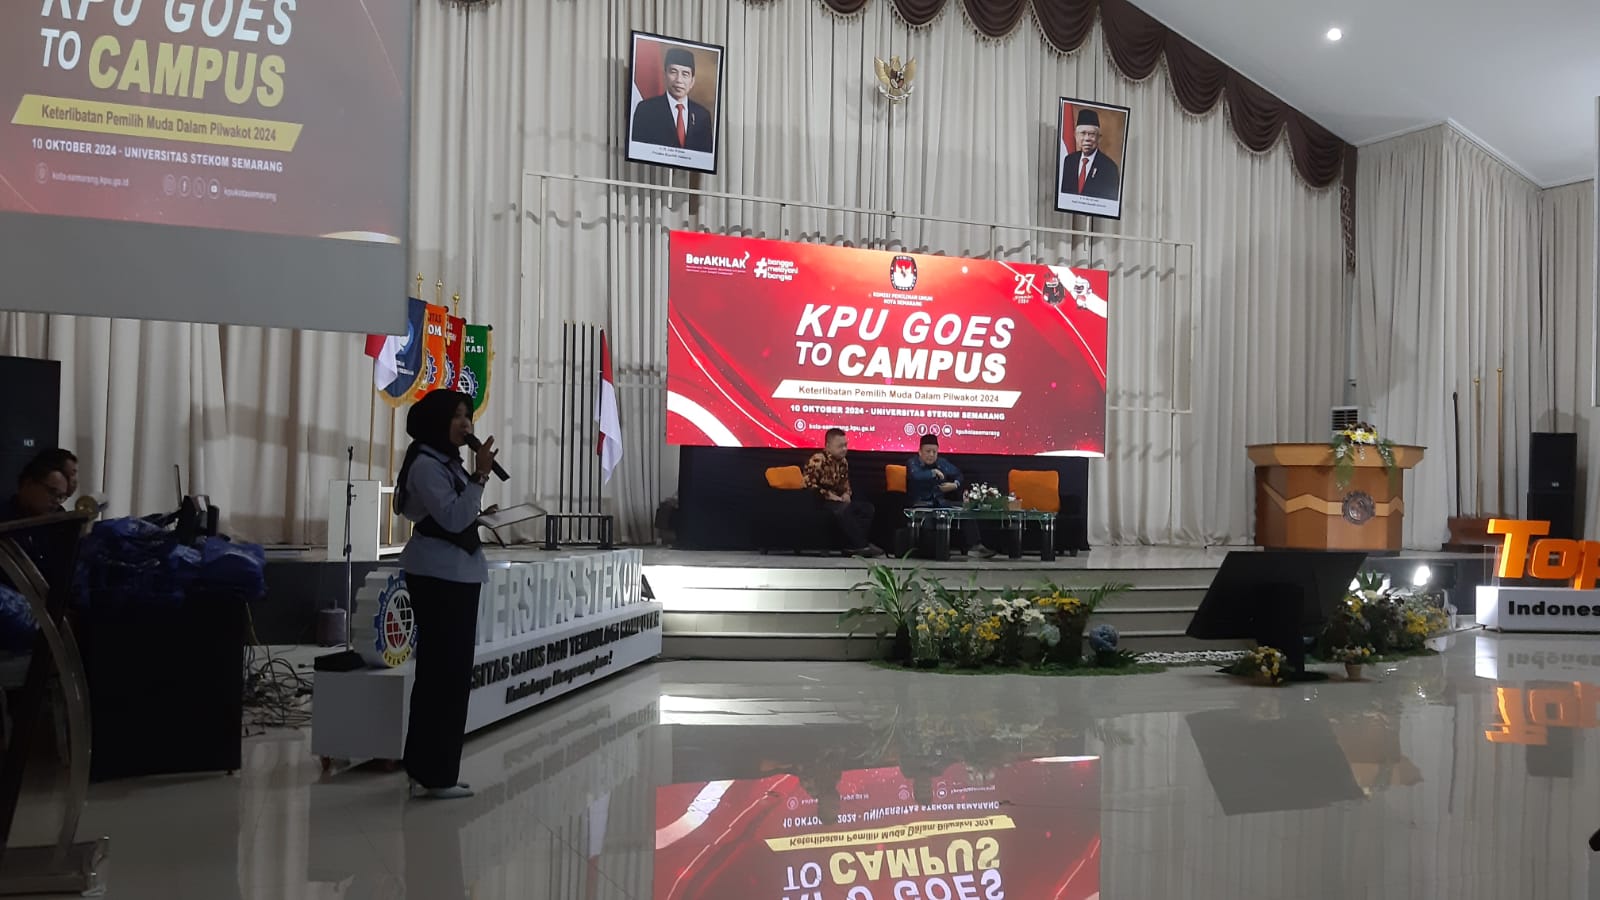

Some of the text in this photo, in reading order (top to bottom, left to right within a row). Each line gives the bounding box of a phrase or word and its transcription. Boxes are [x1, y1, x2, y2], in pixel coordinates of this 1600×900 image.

[164, 0, 296, 46] GOES
[40, 28, 285, 107] TO CAMPUS
[41, 104, 276, 141] Keterlibatan Pemilih Muda Dalam Pilwakot 2024
[32, 138, 43, 149] 10
[45, 139, 92, 154] OKTOBER
[94, 144, 117, 156] 2024
[124, 146, 188, 163] UNIVERSITAS
[190, 154, 229, 167] STEKOM
[231, 157, 283, 173] SEMARANG
[686, 253, 746, 269] BerAKHLAK
[1014, 273, 1036, 295] 27
[795, 303, 1015, 349] KPU GOES
[795, 340, 1007, 384] TO CAMPUS
[790, 404, 800, 412] 10
[802, 405, 843, 414] OKTOBER
[845, 406, 864, 414] 2024
[870, 407, 925, 417] UNIVERSITAS
[927, 410, 960, 418] STEKOM
[961, 411, 1006, 421] SEMARANG
[798, 385, 999, 403] Keterlibatan Pemilih Muda Dalam Pilwakot 2024
[580, 549, 643, 618] STEKOM
[511, 645, 546, 676] SAINS
[546, 638, 568, 665] DAN
